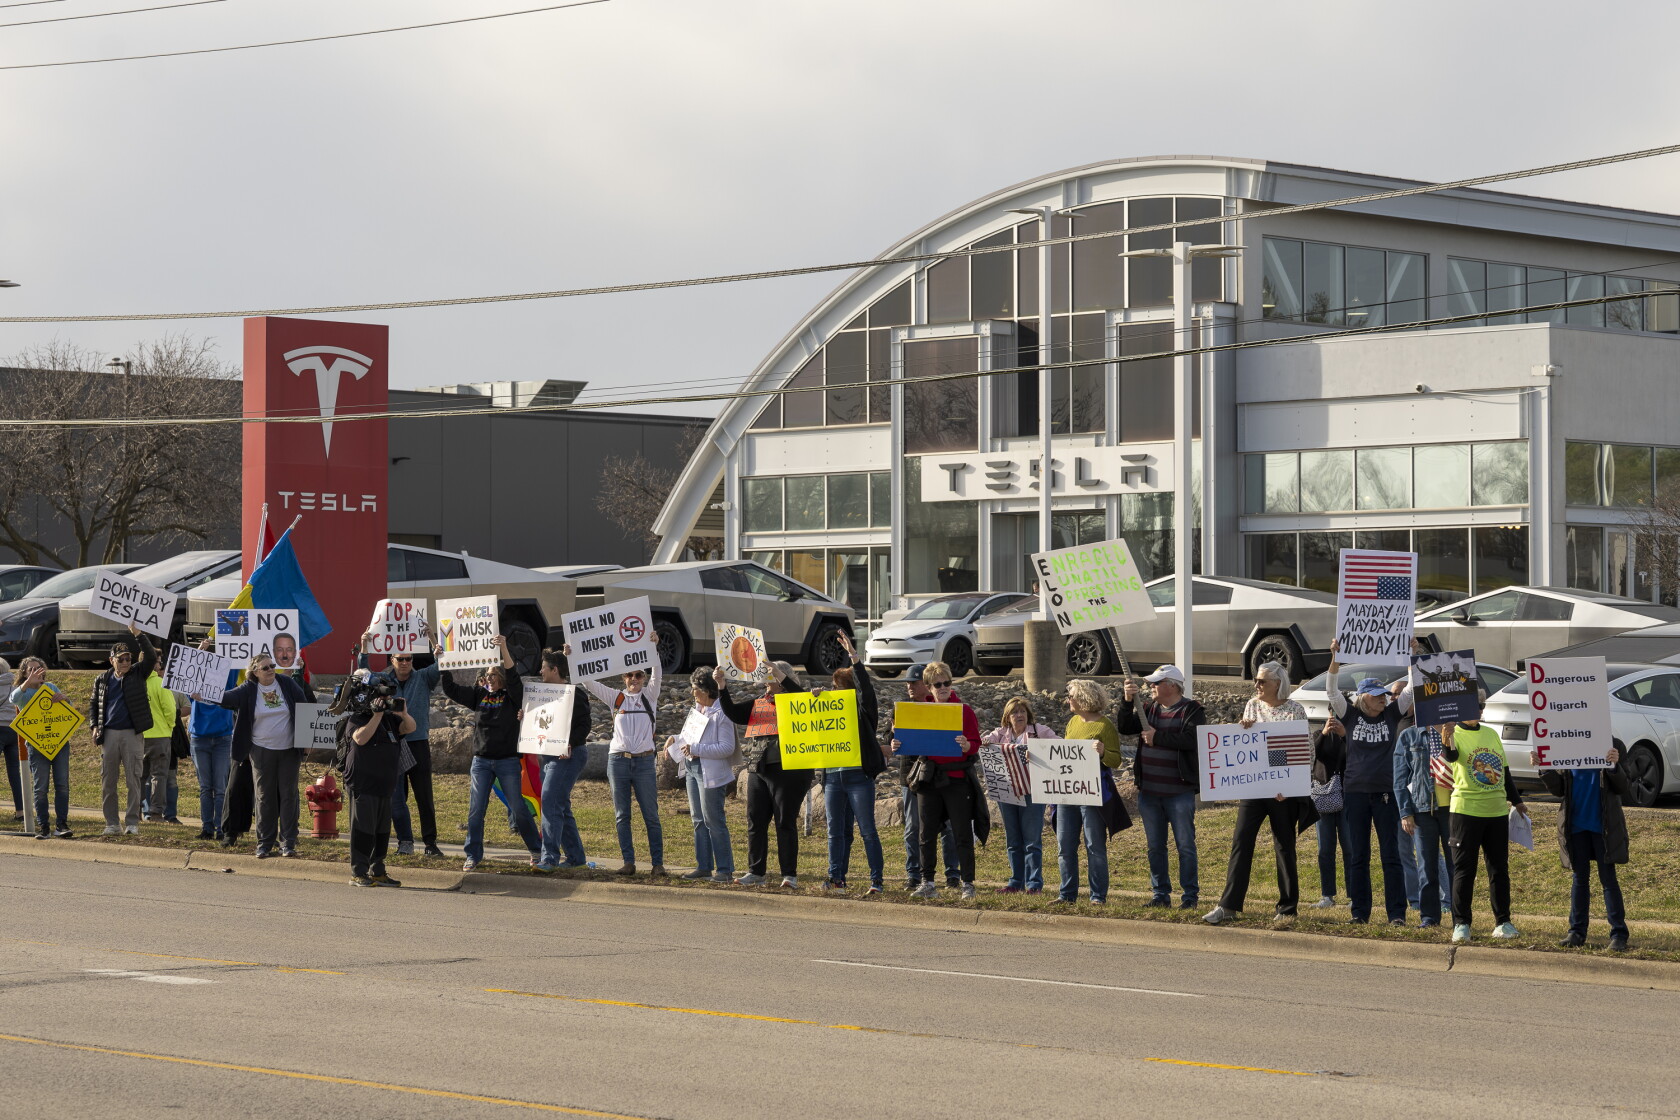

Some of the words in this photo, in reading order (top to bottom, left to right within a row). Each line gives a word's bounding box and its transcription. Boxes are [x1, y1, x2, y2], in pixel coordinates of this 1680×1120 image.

[939, 453, 1148, 492] TESLA
[278, 491, 376, 513] TESLA
[1045, 566, 1120, 592] LUNATIC
[100, 578, 140, 602] DON'T
[140, 592, 171, 612] BUY
[1088, 597, 1107, 606] THE
[99, 596, 159, 629] TESLA
[456, 605, 493, 619] CANCEL
[1057, 602, 1125, 628] NATION
[257, 613, 289, 631] NO
[385, 623, 410, 632] THE
[459, 621, 492, 637] MUSK
[569, 616, 595, 634] HELL
[599, 612, 616, 627] NO
[372, 633, 417, 652] COUP
[458, 639, 479, 652] NOT
[482, 638, 496, 649] US
[581, 634, 615, 653] MUSK
[720, 625, 738, 649] SHIP
[742, 628, 764, 656] MUSK
[171, 645, 225, 670] DEPORT
[577, 658, 609, 677] MUST
[623, 650, 648, 667] GO!!
[167, 660, 208, 683] ELON
[725, 662, 738, 678] TO
[1530, 663, 1596, 685] Dangerous
[1423, 682, 1438, 696] NO
[1532, 690, 1588, 711] Oligarch
[20, 717, 39, 726] Face
[43, 713, 73, 725] Injustice
[810, 717, 846, 732] NAZIS
[1534, 718, 1592, 738] Grabbing
[36, 732, 60, 741] Injustice
[1207, 731, 1268, 750] DEPORT
[1352, 730, 1390, 743] SPORT
[1049, 745, 1087, 761] MUSK
[1208, 750, 1258, 769] ELON
[981, 747, 1001, 800] PRESIDENT
[1060, 765, 1074, 775] IS
[1208, 768, 1291, 789] IMMEDIATELY
[1042, 777, 1100, 797] ILLEGAL!
